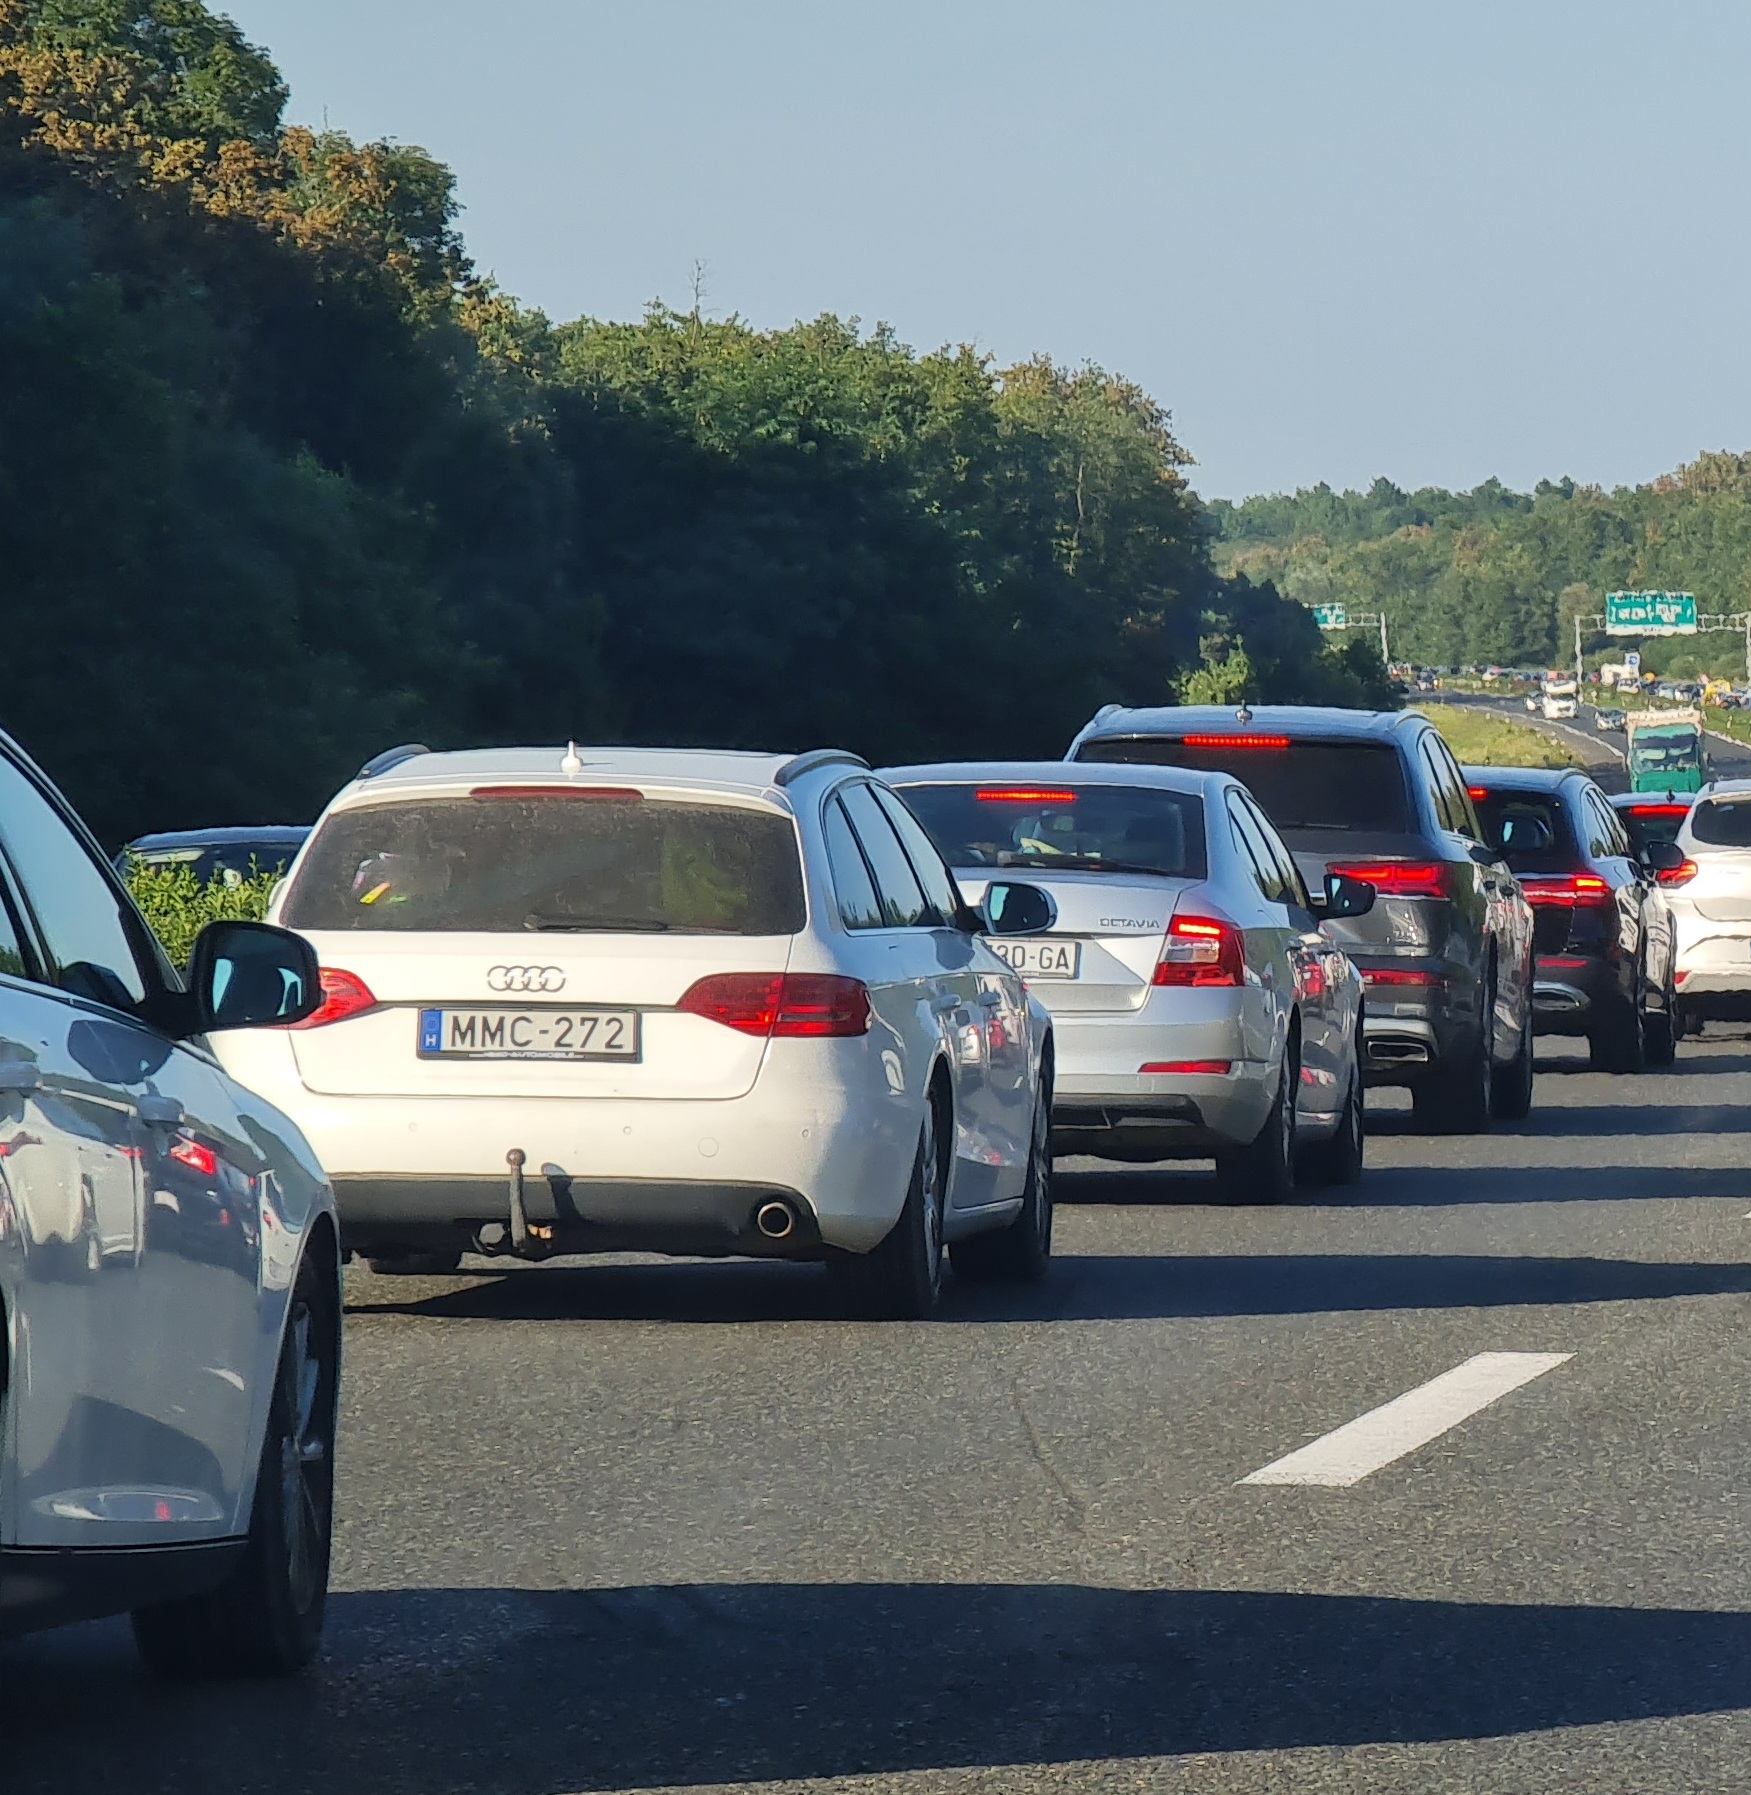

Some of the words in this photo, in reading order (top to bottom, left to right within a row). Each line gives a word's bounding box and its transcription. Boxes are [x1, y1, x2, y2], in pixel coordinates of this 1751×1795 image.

[1100, 918, 1160, 929] OCTAVIA
[988, 944, 1070, 970] 30-GA
[426, 1034, 437, 1047] H
[451, 1015, 625, 1050] MMC-272
